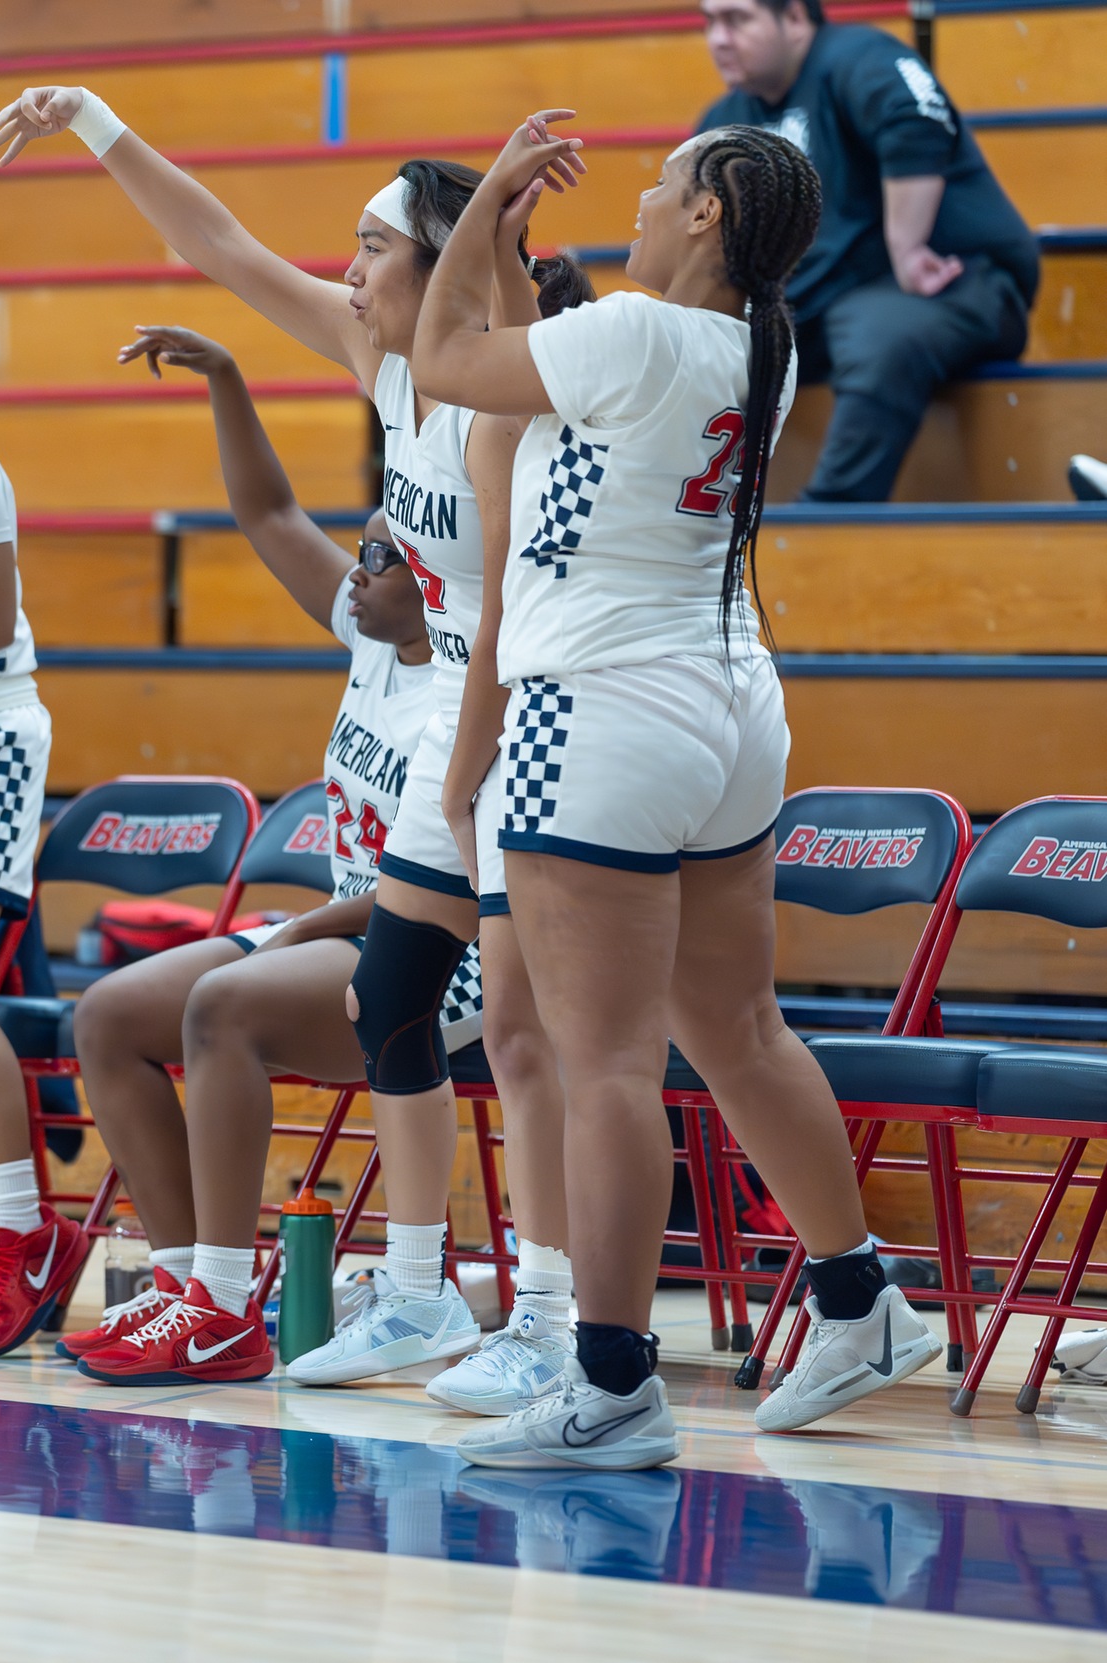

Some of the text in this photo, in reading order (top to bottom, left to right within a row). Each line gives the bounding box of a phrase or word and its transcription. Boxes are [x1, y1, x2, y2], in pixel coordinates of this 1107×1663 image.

[675, 406, 760, 518] 2
[384, 464, 458, 540] MERICAN
[78, 810, 219, 855] BEAVERS
[327, 776, 389, 868] 24
[820, 827, 927, 838] AMERICAN RIVER COLLEGE
[1061, 839, 1107, 850] AMERICA
[775, 824, 924, 869] BEAVERS
[1008, 836, 1107, 882] BEAV
